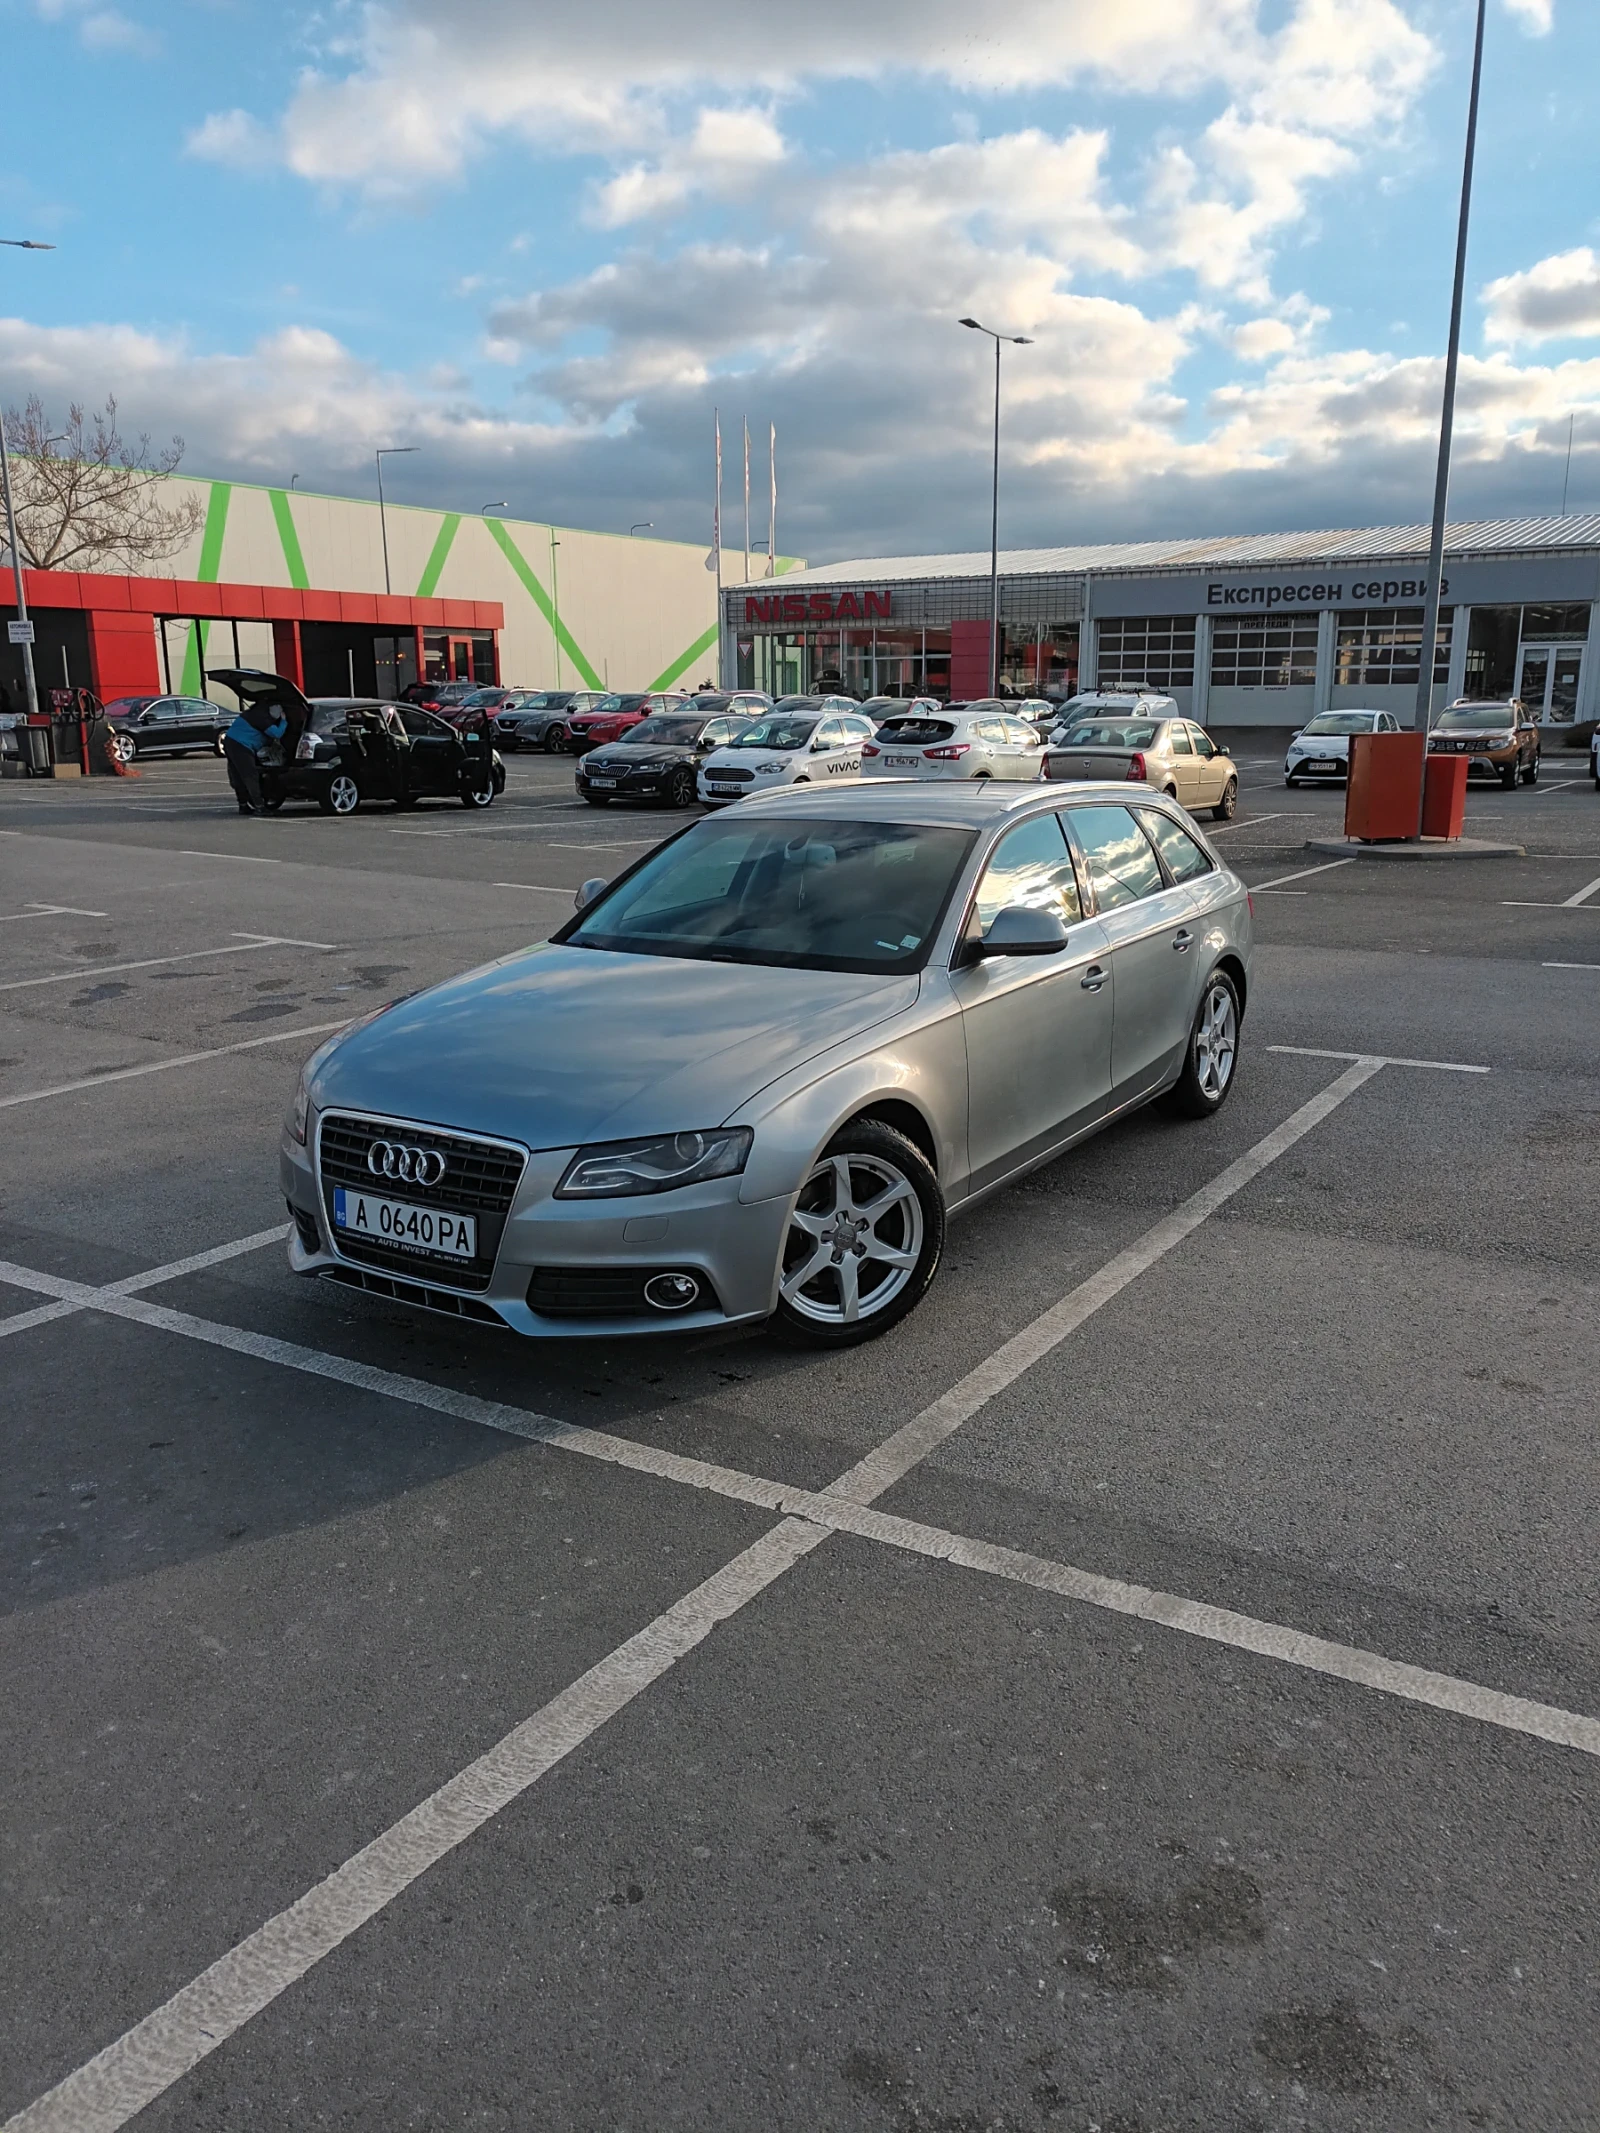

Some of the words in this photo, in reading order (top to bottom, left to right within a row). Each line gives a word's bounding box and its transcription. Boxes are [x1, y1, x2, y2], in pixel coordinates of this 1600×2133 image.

[1207, 583, 1342, 607] Експресен
[745, 590, 892, 623] NISSAN
[1244, 621, 1289, 629] ПРЕГЛЕДИ
[336, 1210, 346, 1221] BG
[356, 1198, 368, 1228] A
[378, 1238, 399, 1249] AUTO
[401, 1243, 431, 1256] INVEST
